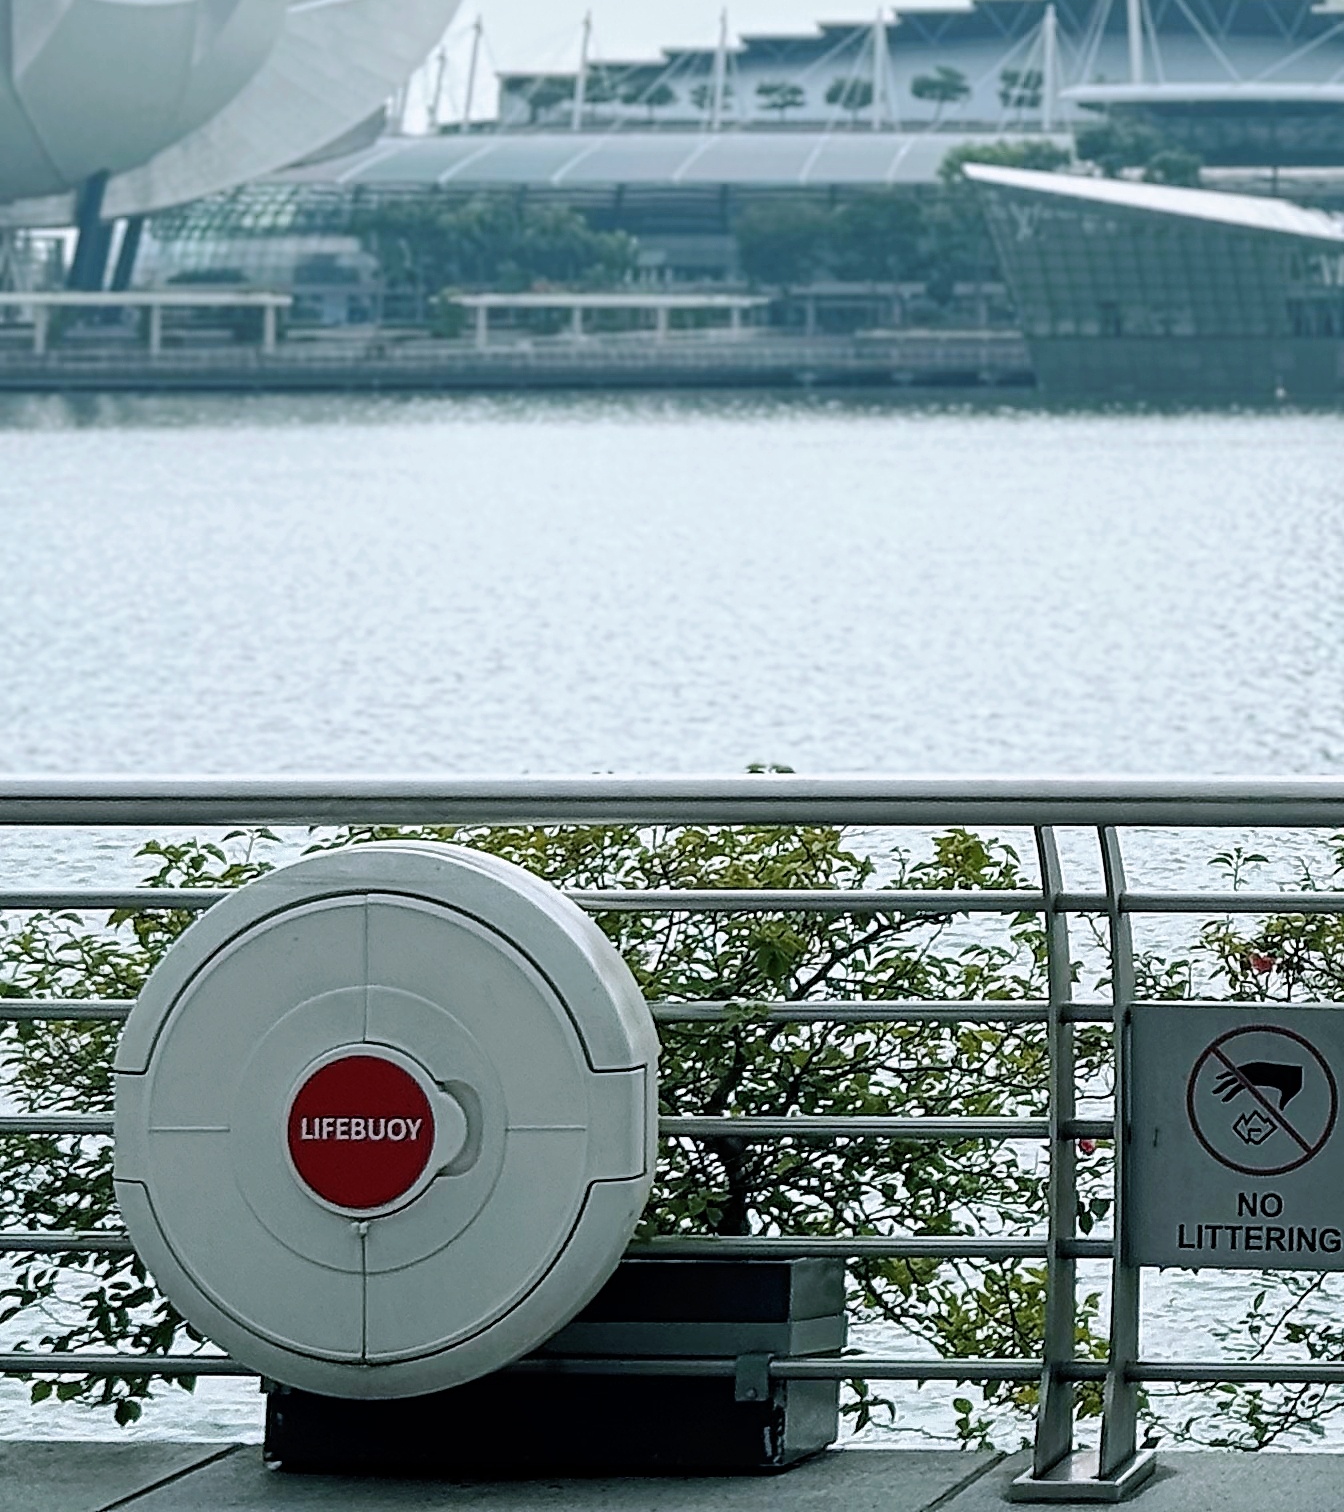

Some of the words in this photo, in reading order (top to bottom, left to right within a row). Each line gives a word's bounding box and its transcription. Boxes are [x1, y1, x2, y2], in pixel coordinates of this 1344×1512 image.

[301, 1117, 423, 1141] LIFEBUOY
[1237, 1192, 1283, 1217] NO
[1178, 1224, 1342, 1253] LITTERING
